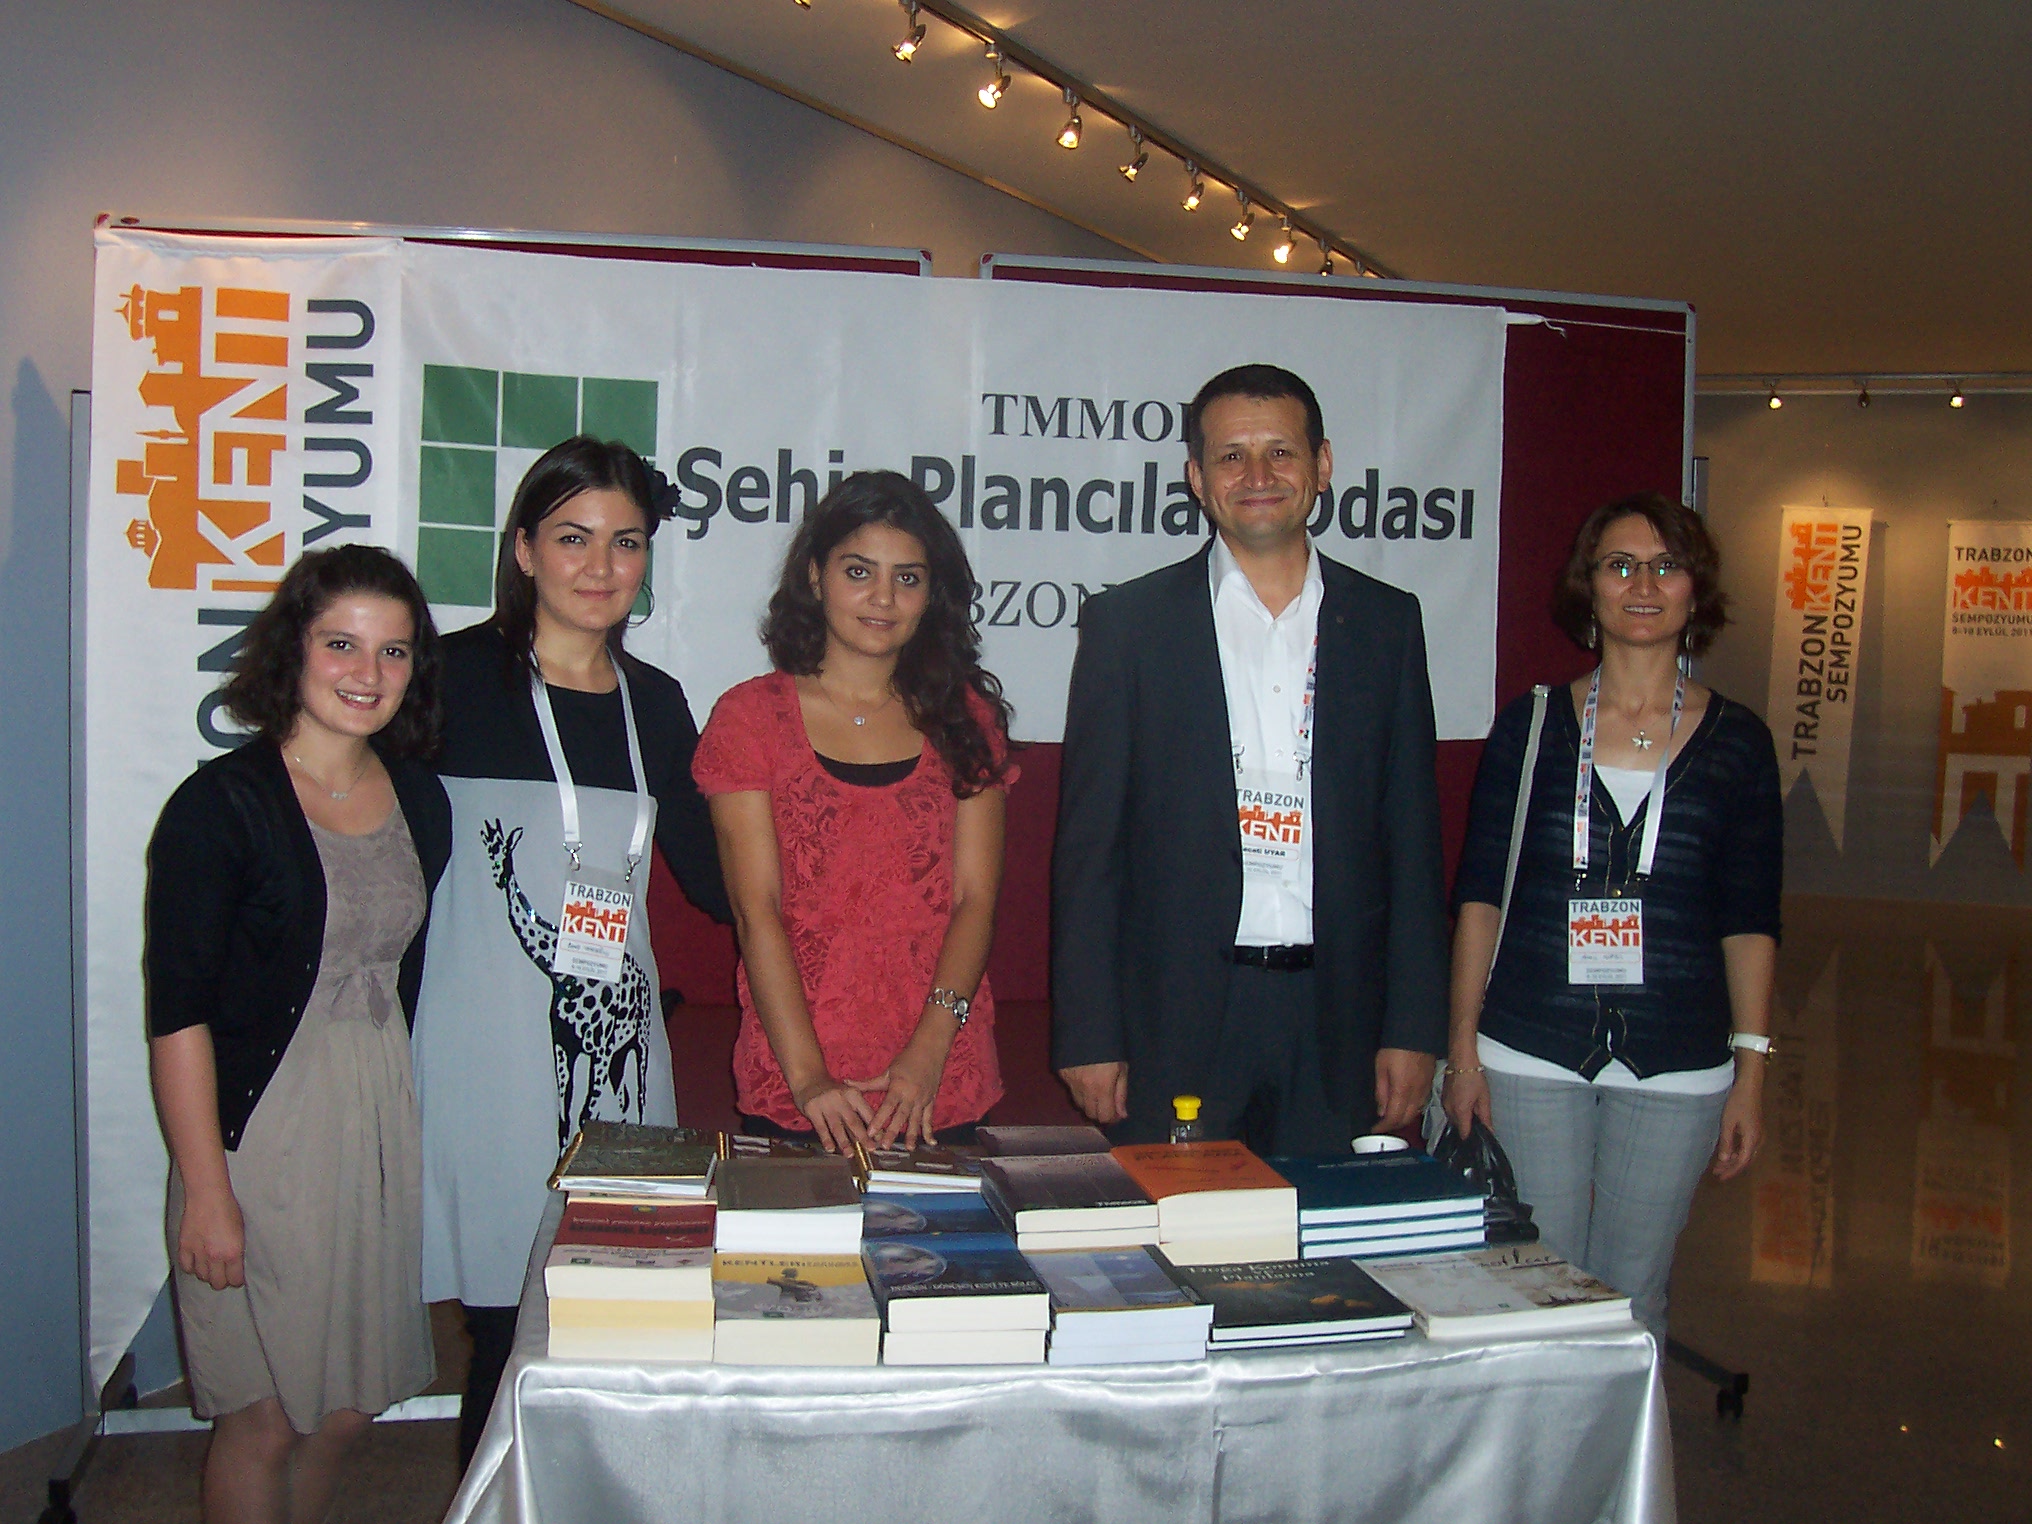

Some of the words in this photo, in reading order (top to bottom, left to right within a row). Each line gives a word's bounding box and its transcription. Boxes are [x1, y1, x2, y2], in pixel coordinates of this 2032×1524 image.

[1825, 523, 1863, 705] SEMPOZYUMU
[1791, 613, 1829, 761] TRABZON
[569, 882, 632, 908] TRABZON
[1570, 901, 1640, 913] TRABZON
